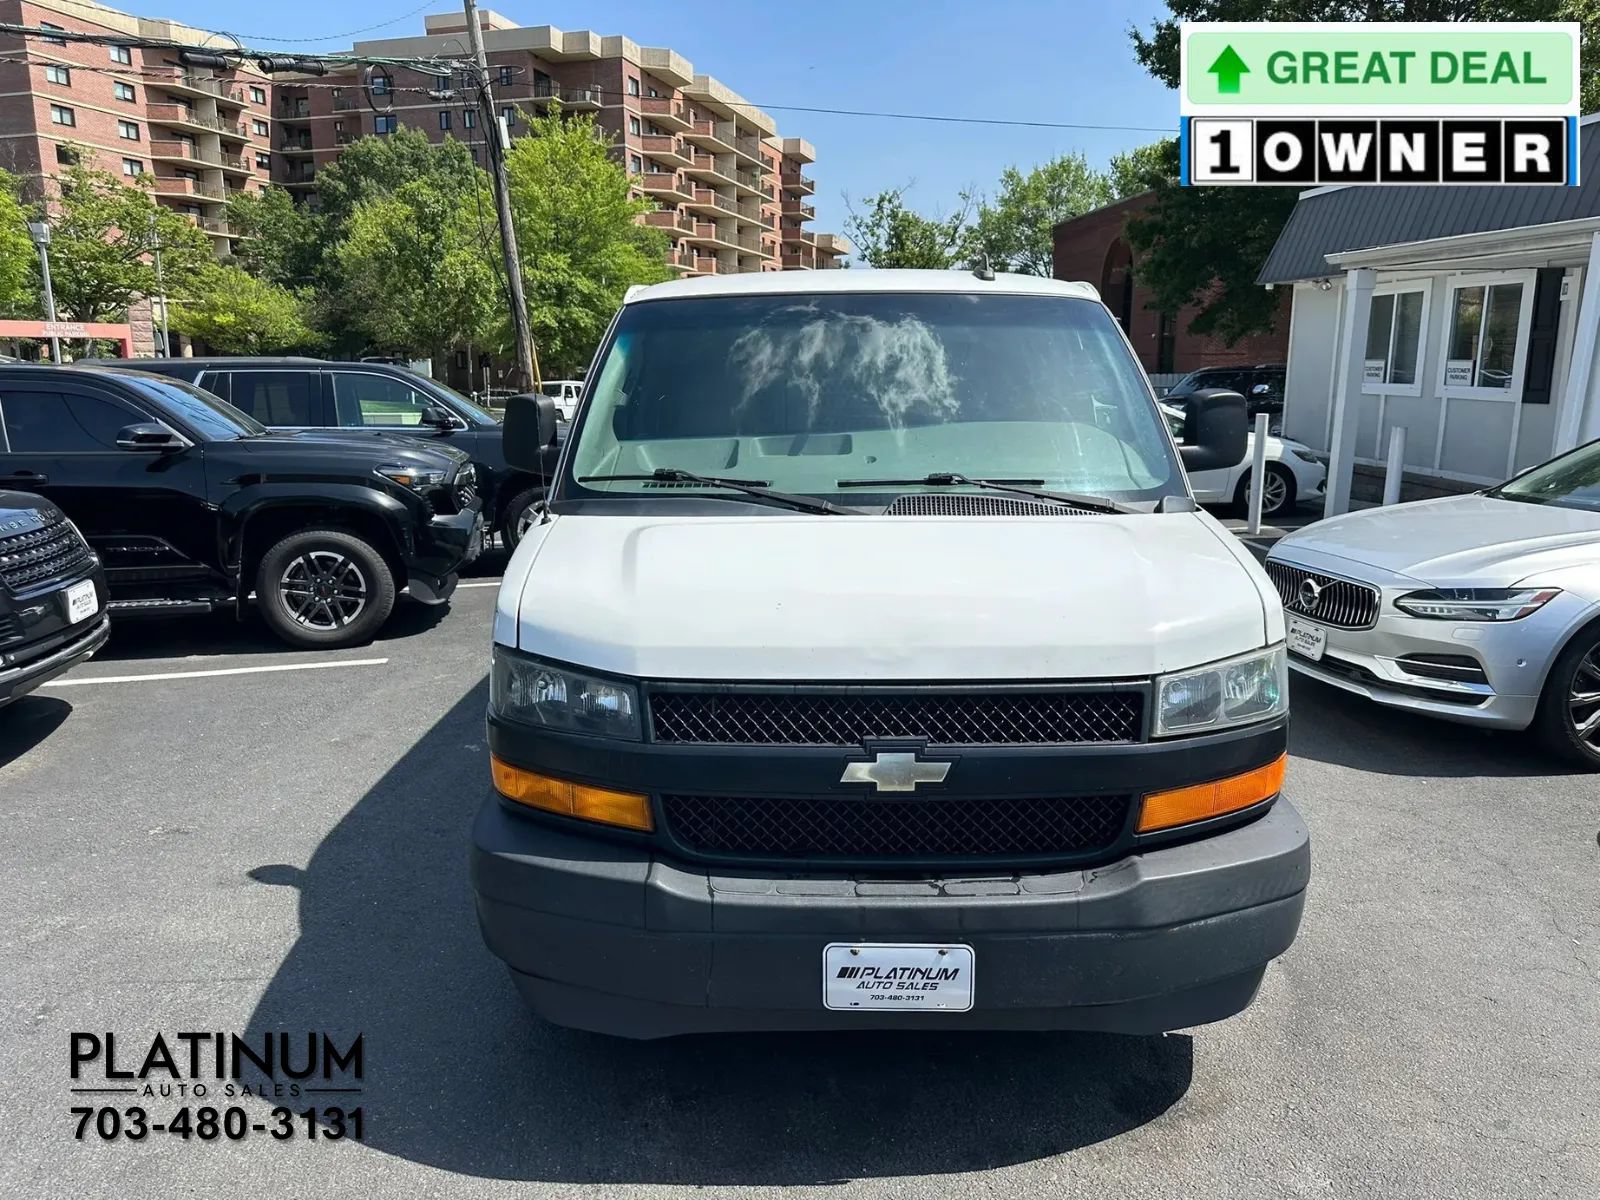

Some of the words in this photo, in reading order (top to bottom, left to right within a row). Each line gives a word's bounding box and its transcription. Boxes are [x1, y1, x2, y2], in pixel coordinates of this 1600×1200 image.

[46, 323, 85, 331] ENTRANCE
[859, 966, 960, 981] PLATINUM
[856, 981, 893, 990] AUTO
[895, 981, 939, 991] SALES
[869, 994, 925, 1002] 703-480-3131
